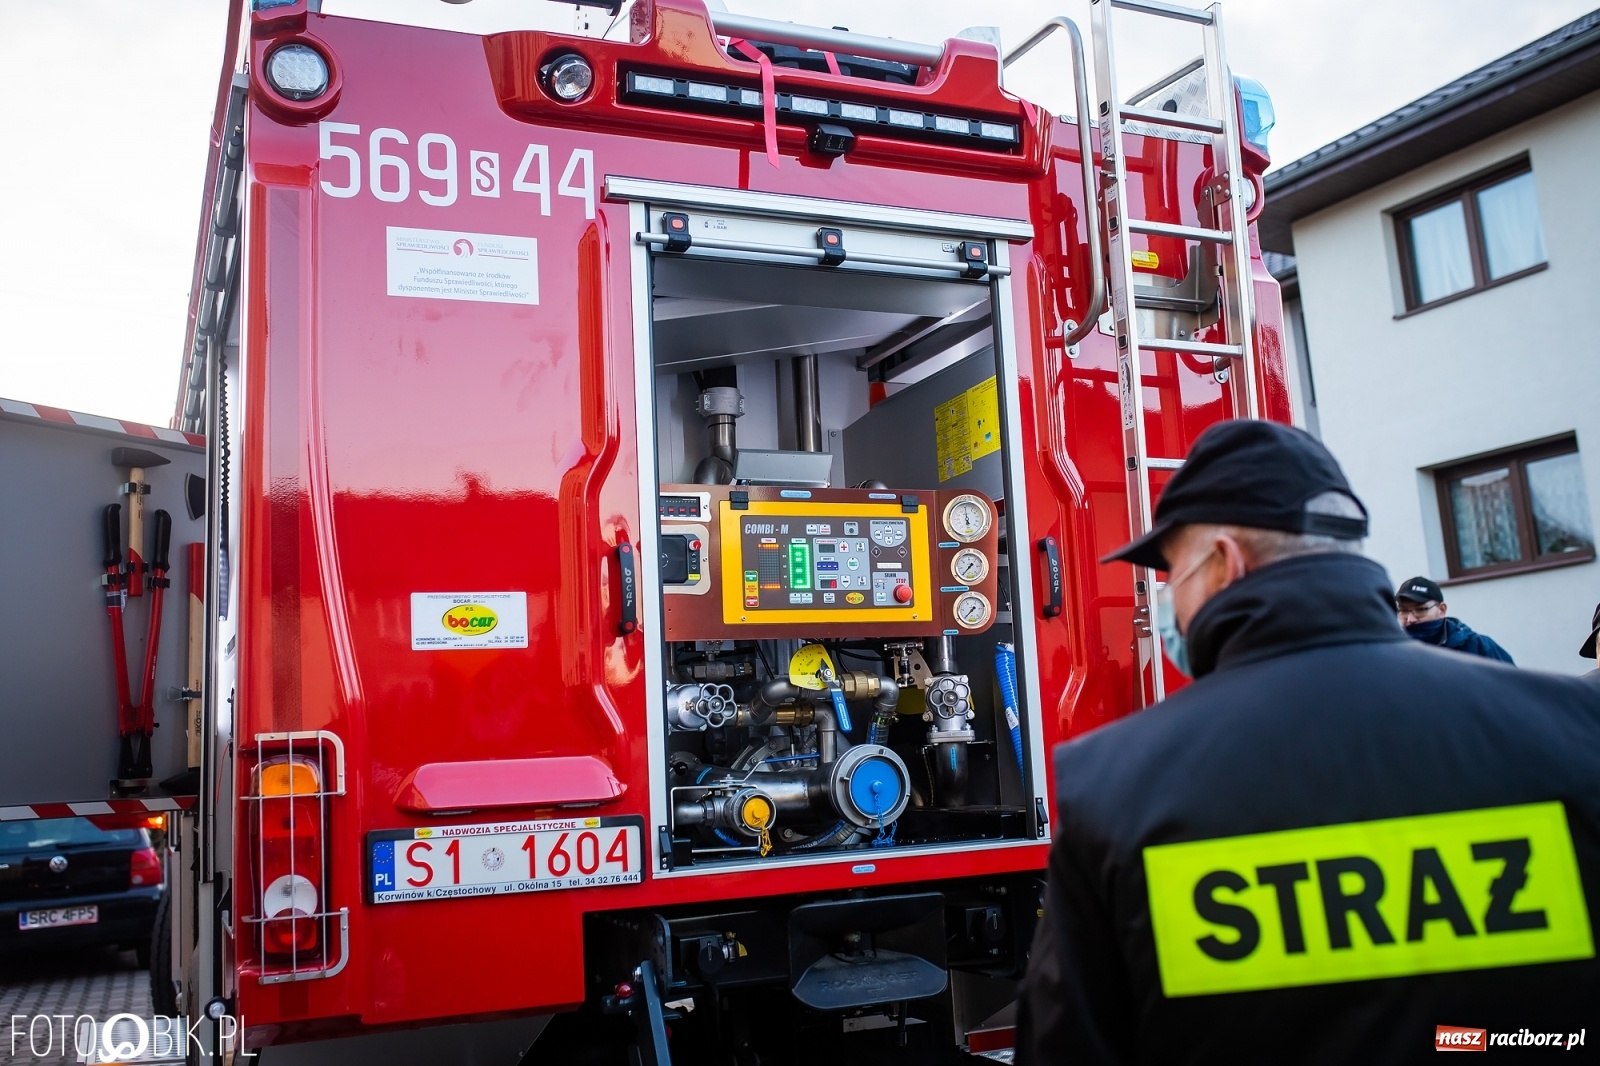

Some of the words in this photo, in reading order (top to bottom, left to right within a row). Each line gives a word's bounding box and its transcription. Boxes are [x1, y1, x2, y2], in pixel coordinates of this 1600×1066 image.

[319, 121, 458, 207] 569
[475, 156, 495, 192] S
[512, 143, 595, 220] 44
[413, 276, 443, 284] Funduszu
[494, 281, 518, 290] którego
[485, 272, 511, 280] środków
[453, 288, 478, 296] Minister
[745, 524, 774, 534] COMBI
[781, 525, 789, 534] M
[1051, 558, 1060, 593] bocar
[624, 568, 633, 607] bocar
[448, 615, 495, 628] bocar
[442, 827, 491, 836] NADWOZIA
[493, 821, 577, 834] SPECJALISTYCZNE
[406, 839, 460, 888] S1
[521, 828, 629, 880] 1604
[375, 873, 392, 887] PL
[377, 891, 425, 902] Korwinów
[426, 885, 497, 897] k/Częstochowy
[504, 884, 515, 892] ul.
[518, 881, 549, 891] Okólna
[551, 879, 562, 888] 15
[569, 878, 583, 887] tel.
[585, 877, 596, 886] 34
[598, 876, 609, 884] 32
[610, 875, 621, 883] 76
[622, 873, 639, 882] 444
[28, 909, 58, 924] SRC
